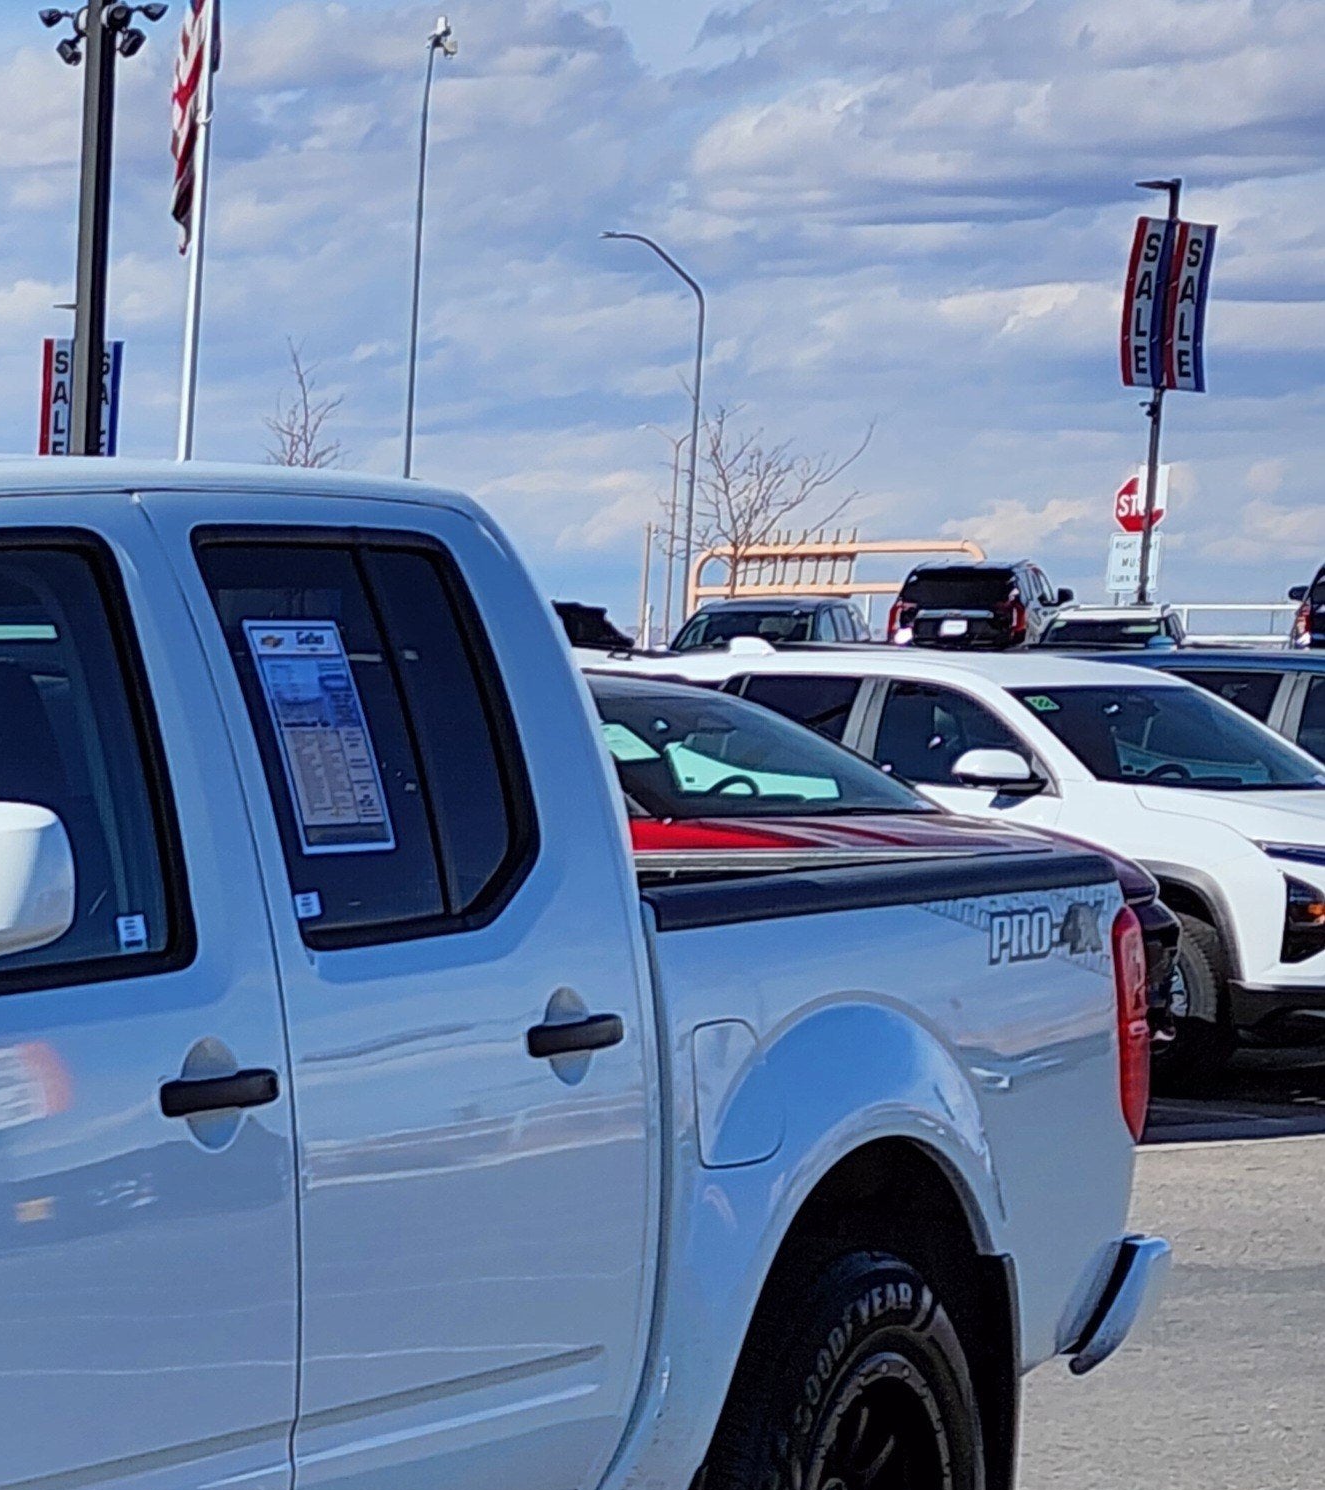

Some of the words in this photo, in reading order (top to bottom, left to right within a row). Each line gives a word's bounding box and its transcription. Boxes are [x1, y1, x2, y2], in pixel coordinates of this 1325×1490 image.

[1134, 233, 1161, 374] SALE
[1177, 238, 1202, 378] SALE
[988, 901, 1104, 966] PRO-4X
